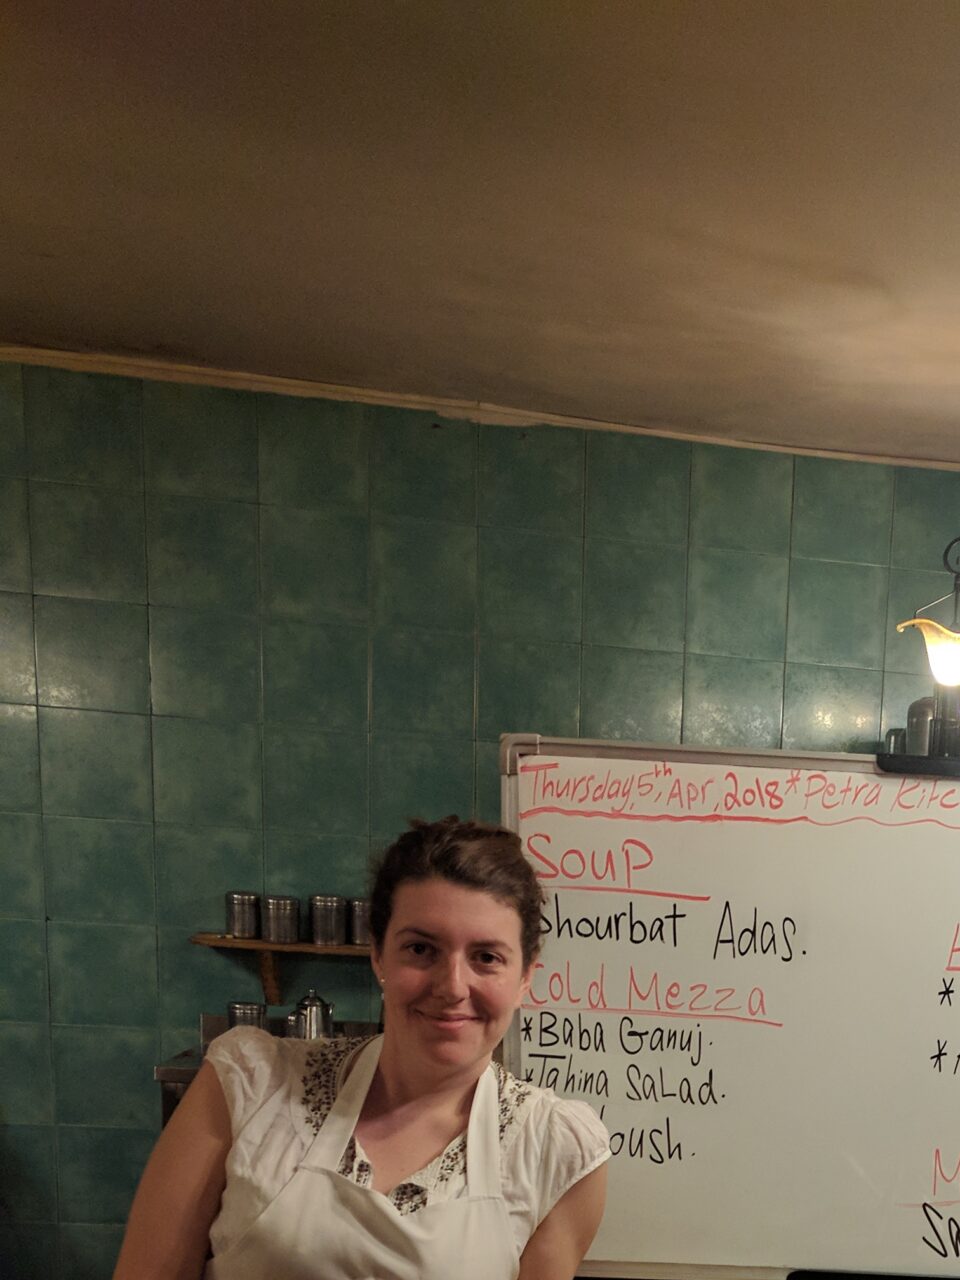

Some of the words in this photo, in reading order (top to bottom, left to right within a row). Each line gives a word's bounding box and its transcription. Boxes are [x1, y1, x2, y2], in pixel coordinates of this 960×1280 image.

[713, 900, 807, 961] Adas.
[628, 966, 766, 1016] Mezza
[619, 1016, 713, 1067] Ganuj.
